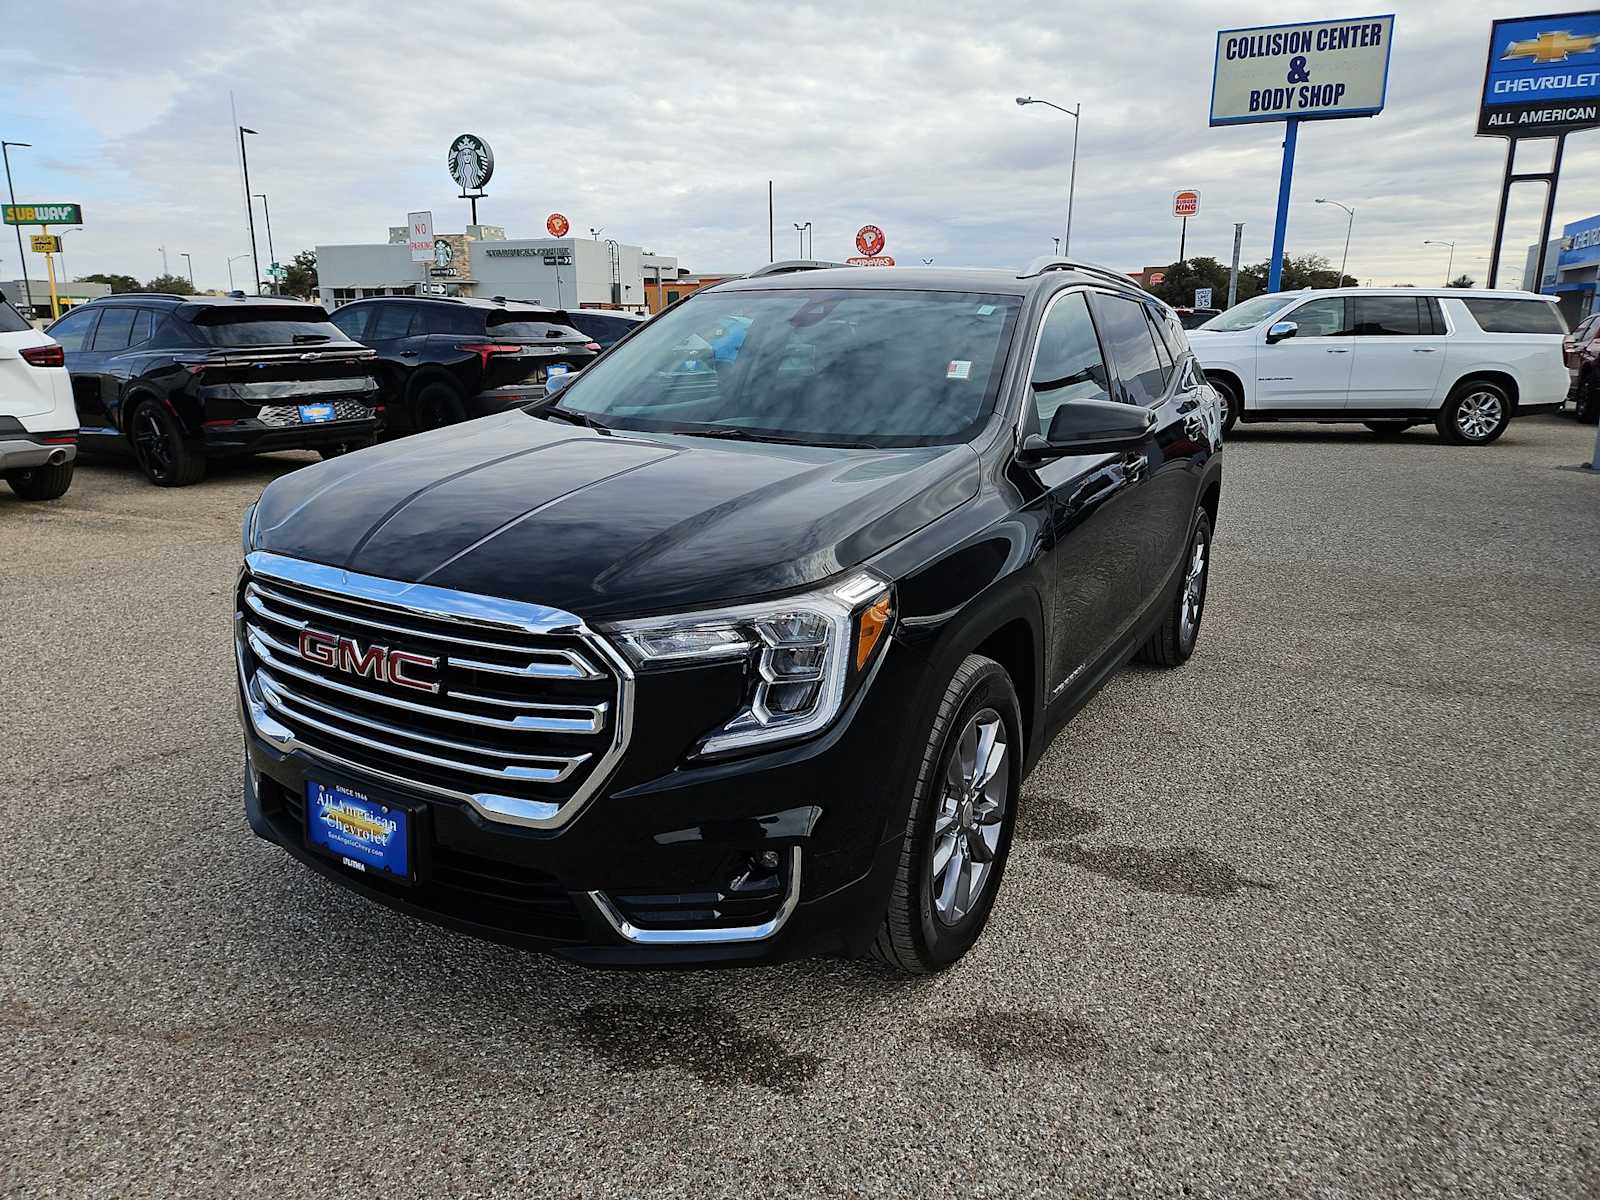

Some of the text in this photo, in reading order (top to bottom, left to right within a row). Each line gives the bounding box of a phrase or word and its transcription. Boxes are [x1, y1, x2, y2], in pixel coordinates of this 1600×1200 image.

[1226, 23, 1382, 60] COLLISION CENTER
[1287, 55, 1310, 83] &
[1494, 73, 1600, 94] CHEVROLET
[1249, 83, 1345, 112] BODY SHOP
[1488, 106, 1597, 126] ALL AMERICAN
[6, 206, 72, 221] SUBWAY
[415, 223, 427, 235] NO
[409, 241, 432, 251] PARKING
[1197, 299, 1210, 307] 35
[299, 629, 440, 694] GMC
[336, 785, 354, 796] SINCE
[316, 792, 397, 832] All American
[327, 814, 388, 847] Chevrolet
